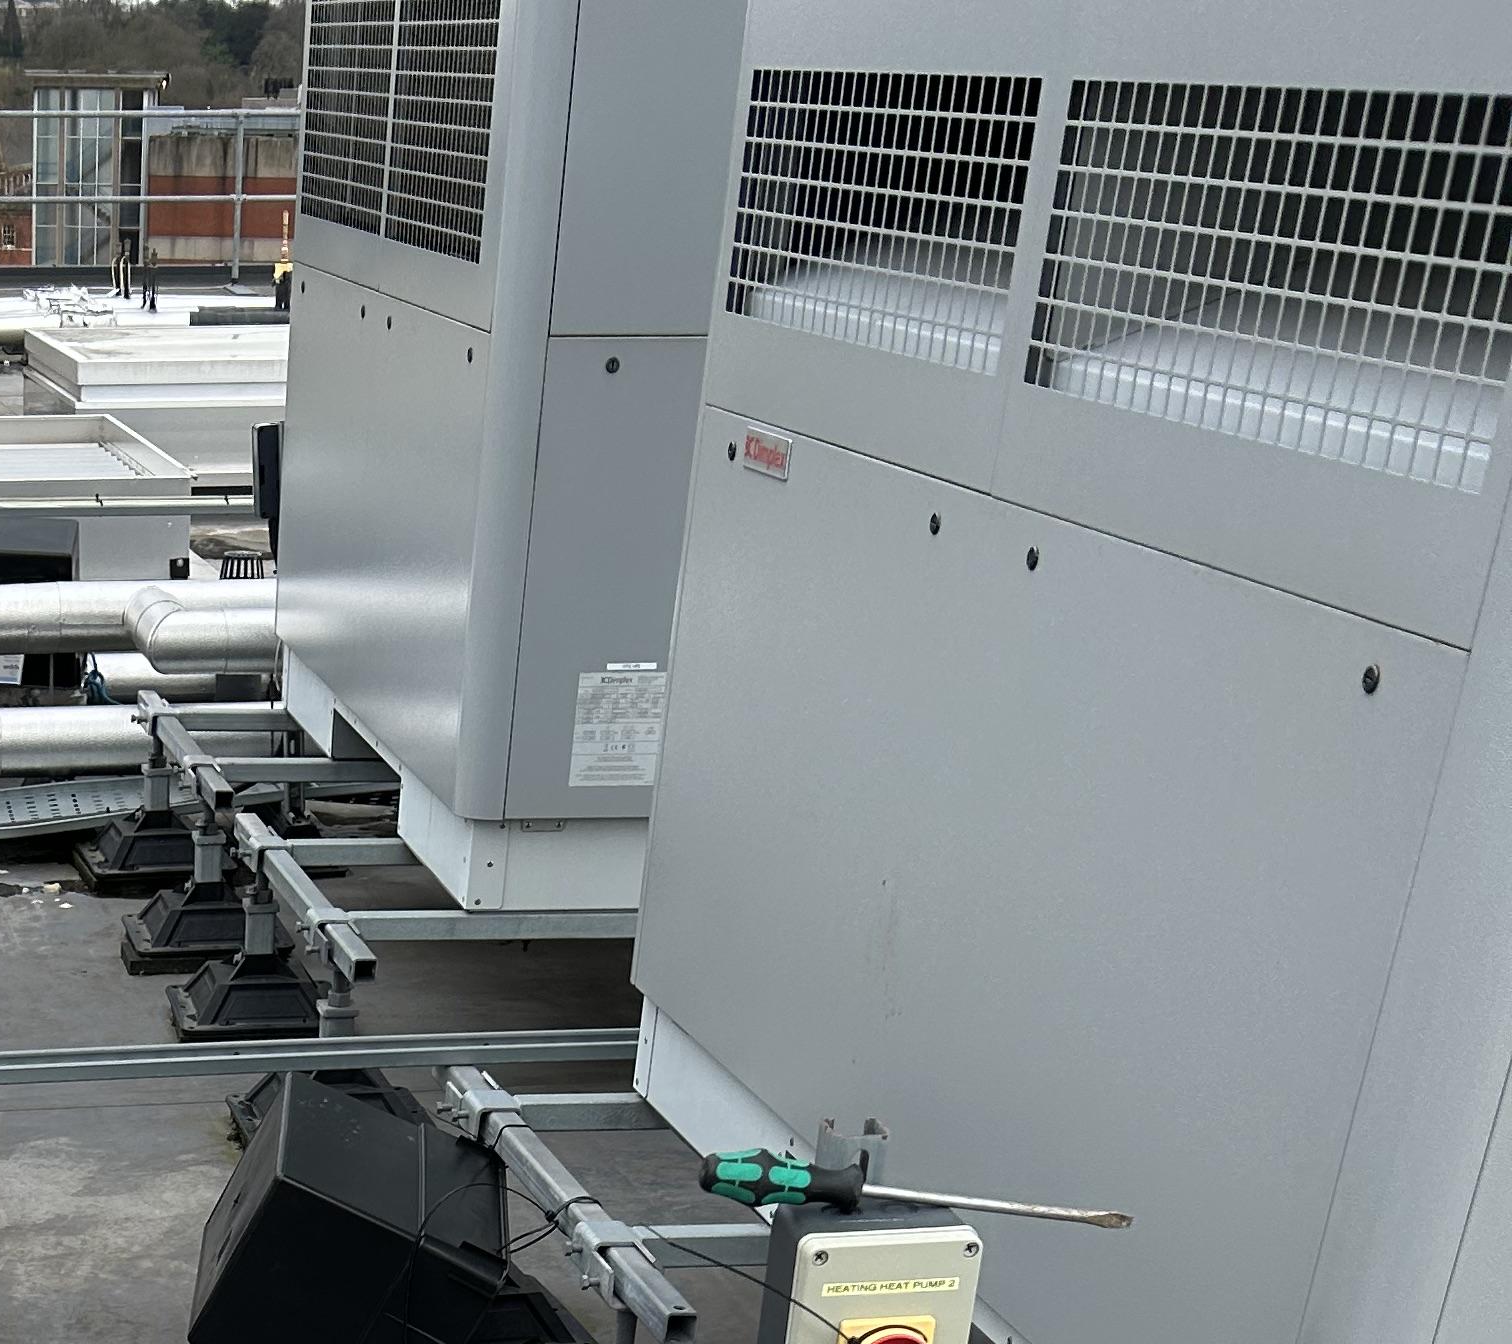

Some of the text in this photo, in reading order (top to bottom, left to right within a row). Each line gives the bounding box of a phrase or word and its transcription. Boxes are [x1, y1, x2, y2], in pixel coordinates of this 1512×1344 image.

[826, 1279, 956, 1293] HEATING HEAT PUMP 2
